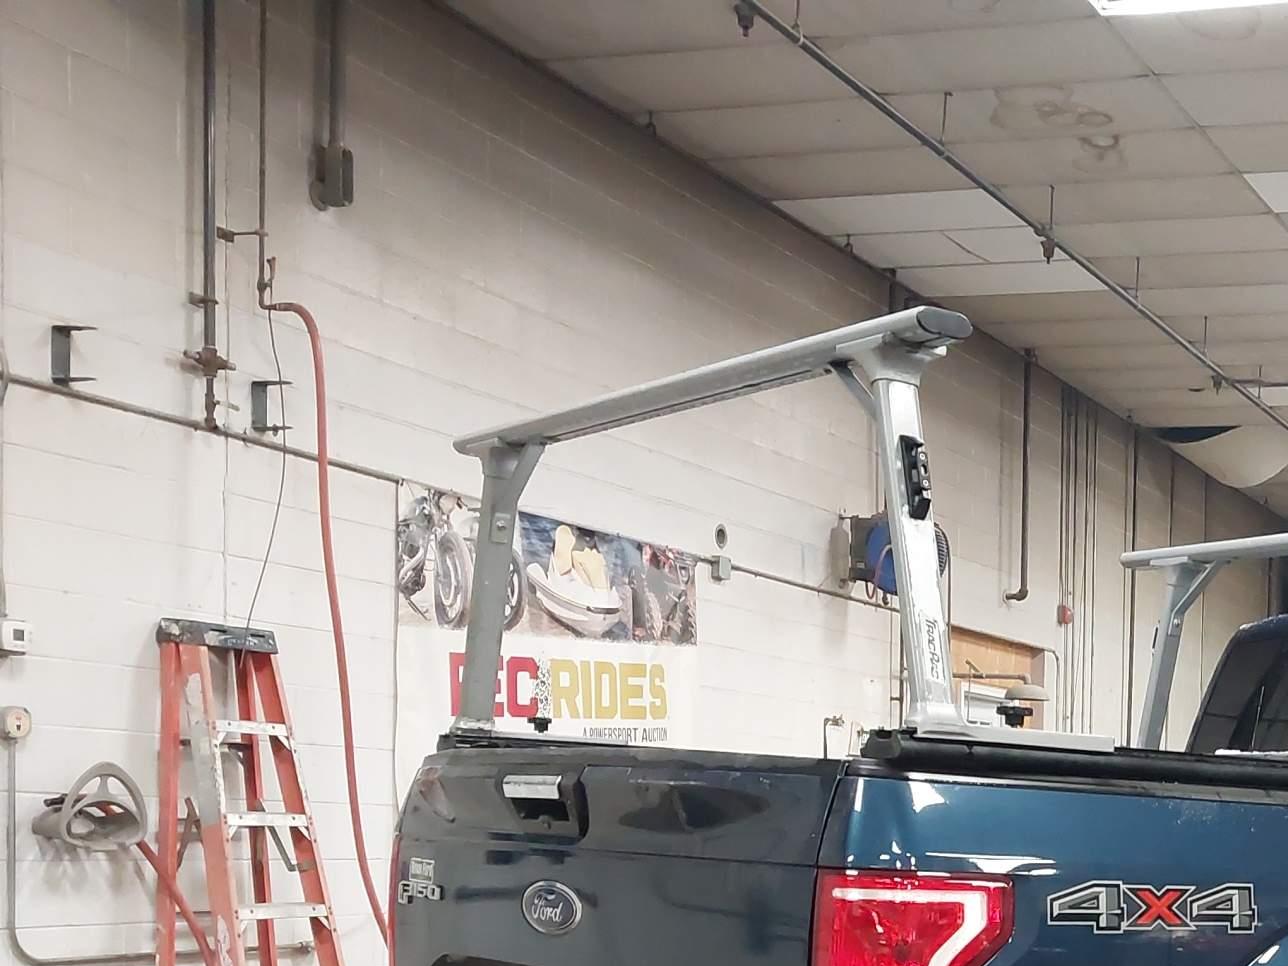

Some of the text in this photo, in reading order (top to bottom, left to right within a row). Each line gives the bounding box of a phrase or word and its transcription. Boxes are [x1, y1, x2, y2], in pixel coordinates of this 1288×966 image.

[550, 658, 668, 720] RIDES
[641, 727, 668, 742] AUCTION
[531, 893, 564, 922] Ford
